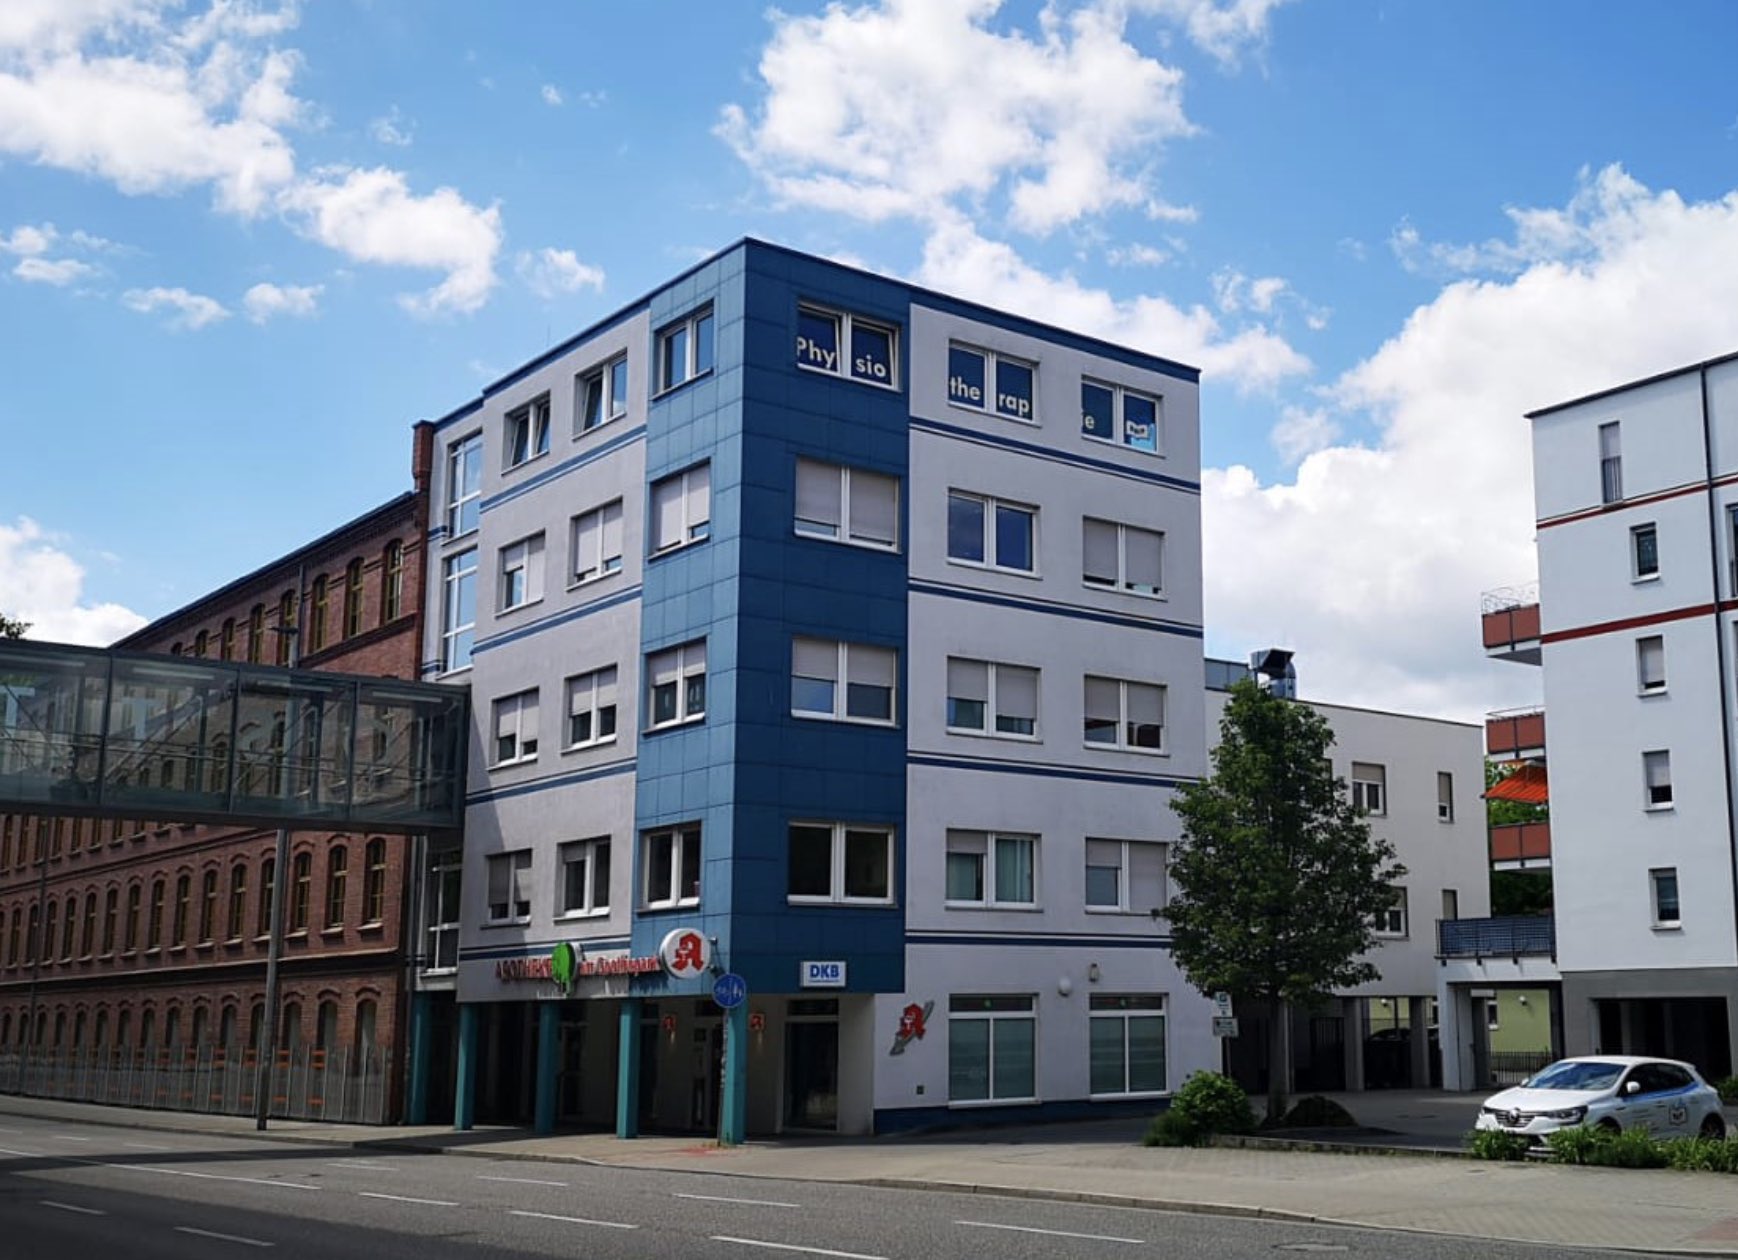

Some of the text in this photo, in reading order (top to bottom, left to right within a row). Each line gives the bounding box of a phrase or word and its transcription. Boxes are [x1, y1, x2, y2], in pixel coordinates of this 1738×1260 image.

[797, 335, 836, 369] Phy
[855, 354, 886, 377] sio
[950, 376, 981, 400] the
[999, 393, 1030, 416] rap
[810, 964, 840, 978] DKB
